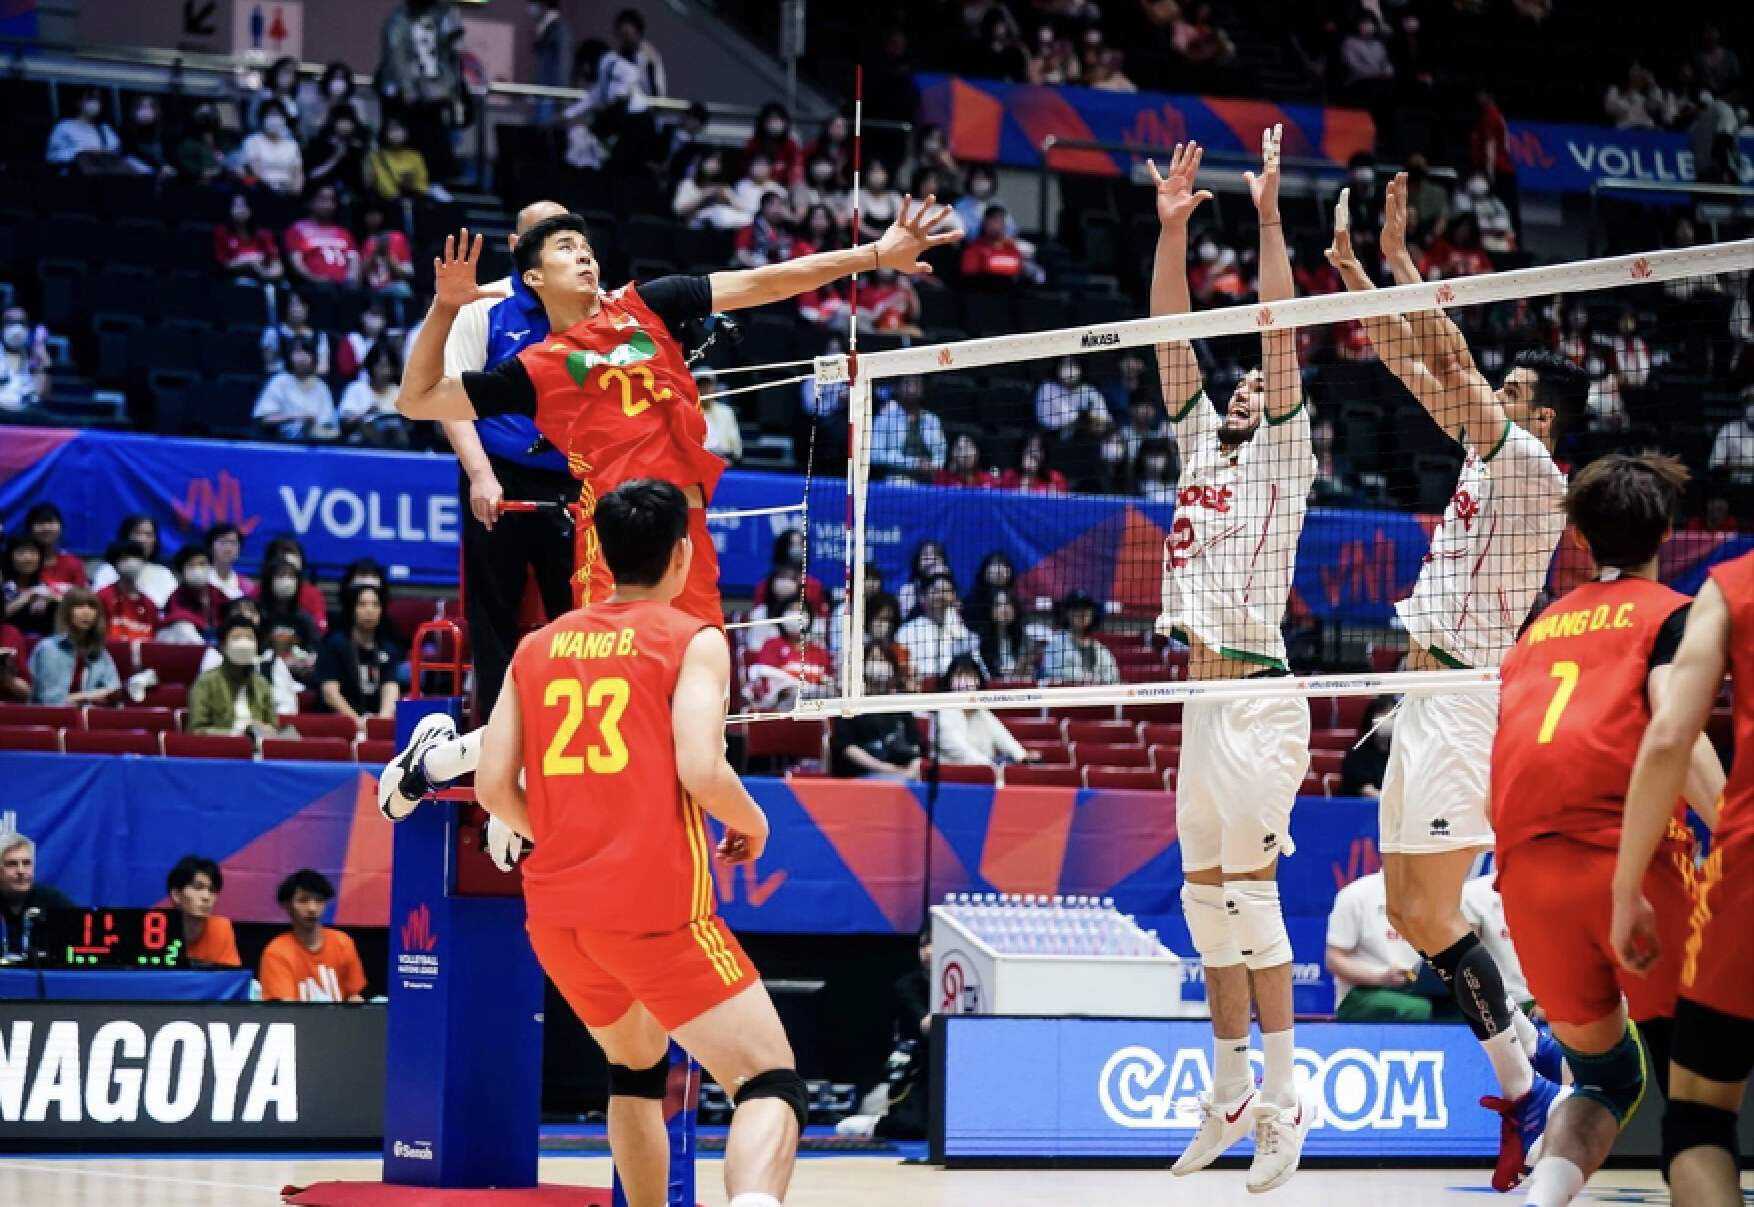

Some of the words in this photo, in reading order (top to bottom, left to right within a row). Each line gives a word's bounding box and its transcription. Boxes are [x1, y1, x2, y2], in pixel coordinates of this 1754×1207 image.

[550, 630, 617, 659] WANG
[616, 628, 638, 656] B.
[543, 677, 631, 776] 23
[1536, 661, 1580, 744] 7
[143, 911, 169, 949] 8
